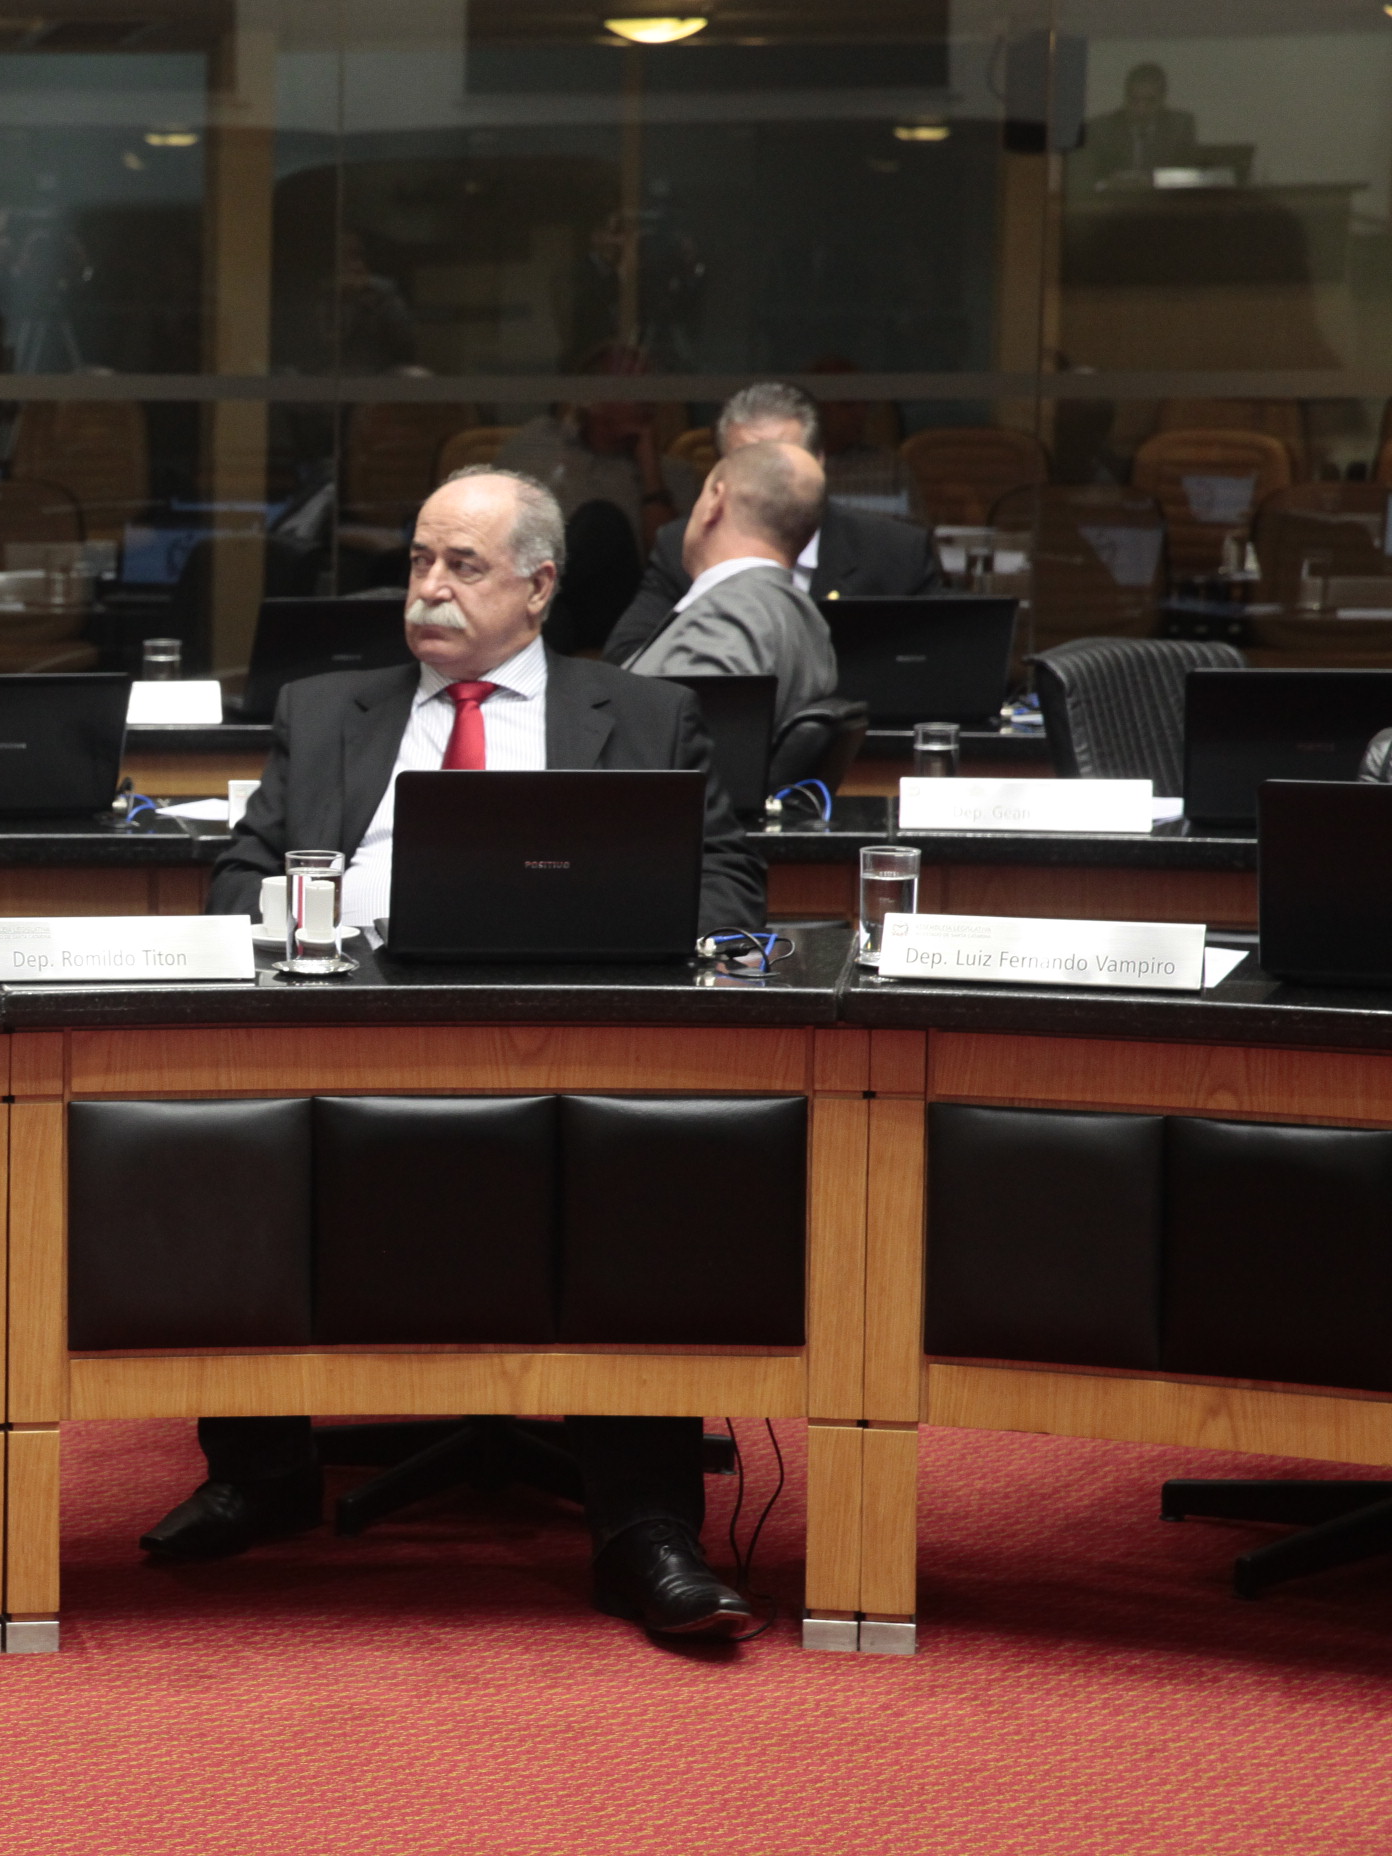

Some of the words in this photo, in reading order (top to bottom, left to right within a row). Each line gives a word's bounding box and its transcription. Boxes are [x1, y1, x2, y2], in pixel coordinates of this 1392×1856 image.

[12, 951, 54, 972] Dep.
[62, 950, 135, 967] Romildo
[143, 949, 187, 966] Titon
[905, 947, 947, 968] Dep.
[956, 949, 992, 967] Luiz
[999, 951, 1088, 971] Fernando
[1095, 955, 1176, 978] Vampiro
